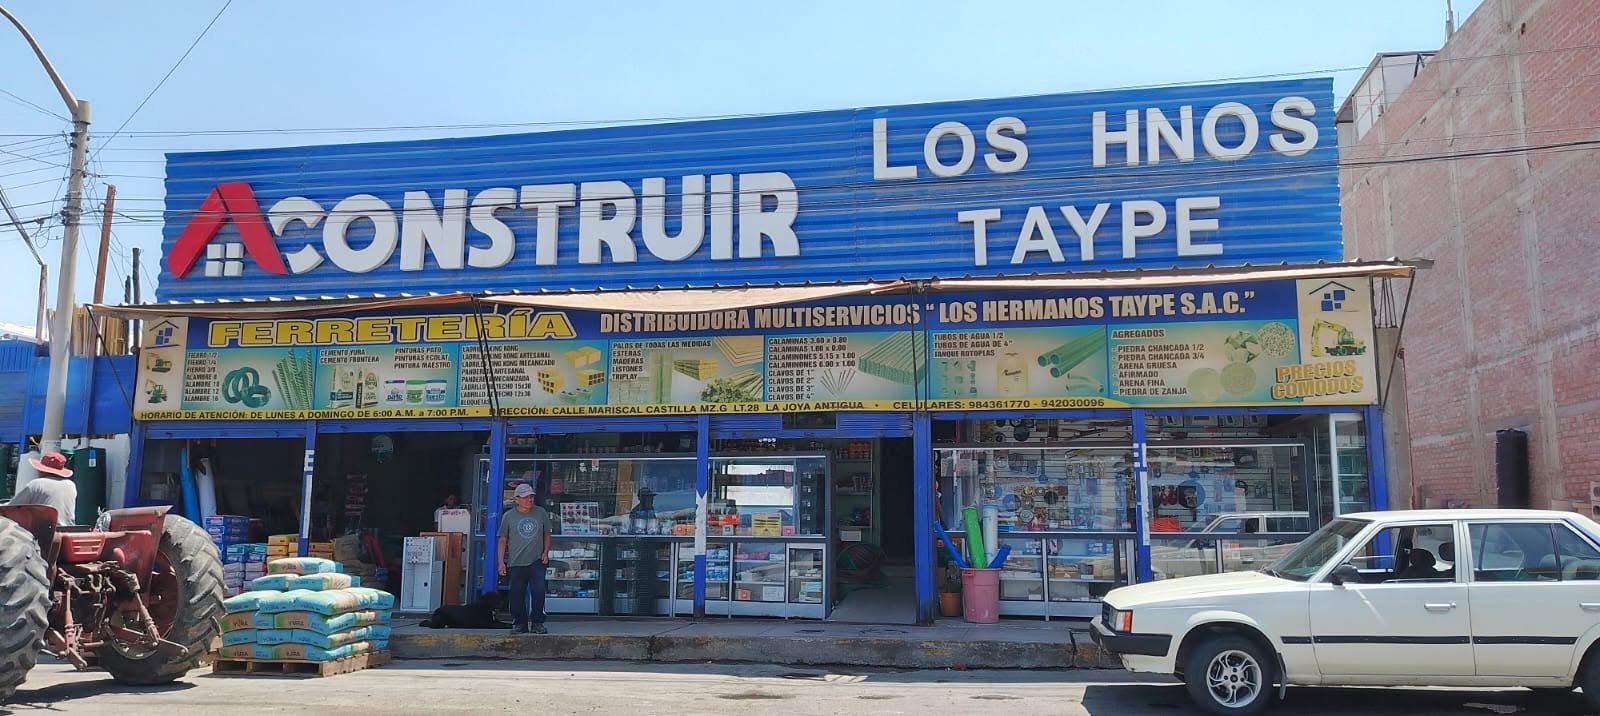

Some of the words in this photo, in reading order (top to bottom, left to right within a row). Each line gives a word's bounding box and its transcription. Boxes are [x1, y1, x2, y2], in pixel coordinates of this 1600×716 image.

[873, 116, 1029, 181] LOS
[1092, 96, 1319, 168] HNOS
[958, 197, 1223, 267] TAYPE
[600, 310, 750, 333] DISTRIBUIDORA
[754, 304, 920, 328] MULTISERVICIOS
[939, 301, 977, 323] LOS
[983, 296, 1104, 322] HERMANOS
[1108, 293, 1176, 317] TAYPE
[209, 309, 576, 347] FERRETERÍA
[1112, 329, 1165, 338] AGREGADOS
[1148, 344, 1190, 352] CHANCADA
[1276, 360, 1356, 383] PRECIOS
[1271, 376, 1364, 400] COMODOS
[141, 411, 182, 419] HORARIO
[307, 410, 355, 418] DOMINGO
[395, 409, 415, 417] A.M.
[588, 406, 643, 414] MARISCAL
[646, 405, 697, 413] CASTILLA
[700, 404, 727, 412] MZ.G
[733, 404, 759, 412] LT.28
[782, 403, 811, 411] JOYA
[814, 402, 864, 410] ANTIGUA
[893, 401, 965, 409] CELULARES:
[969, 400, 1030, 409] 984361770
[1041, 399, 1104, 408] 942030096
